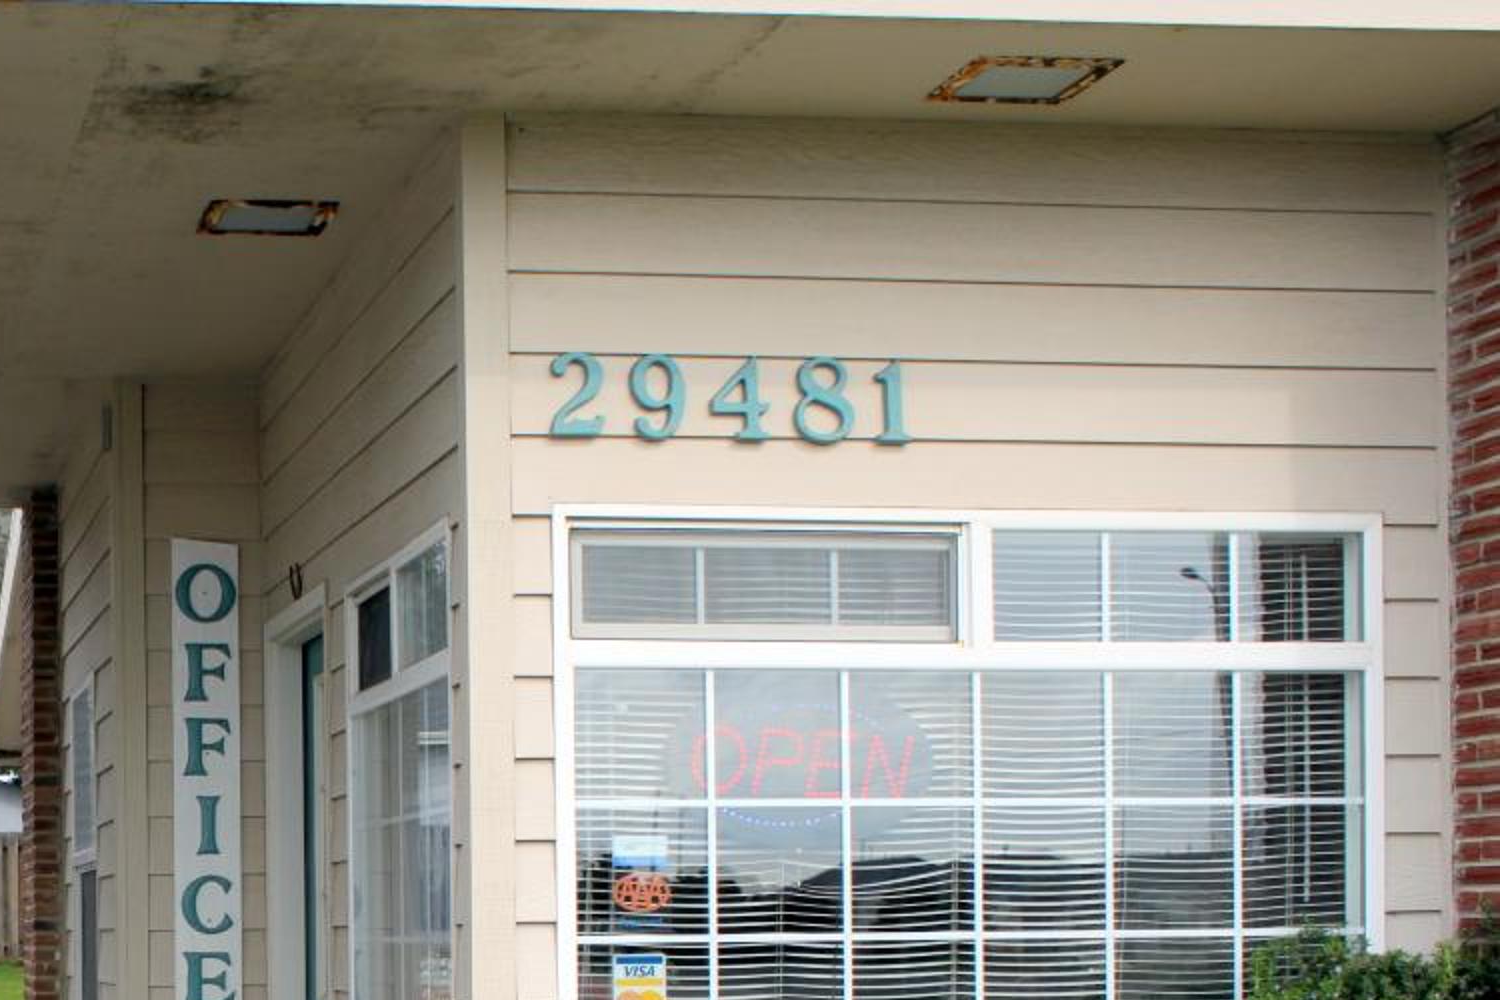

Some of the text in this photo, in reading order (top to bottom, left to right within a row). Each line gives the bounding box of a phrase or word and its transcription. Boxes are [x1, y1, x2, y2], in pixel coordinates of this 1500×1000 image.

[549, 352, 911, 446] 29481
[690, 721, 916, 800] OPEN
[623, 965, 656, 978] VISA
